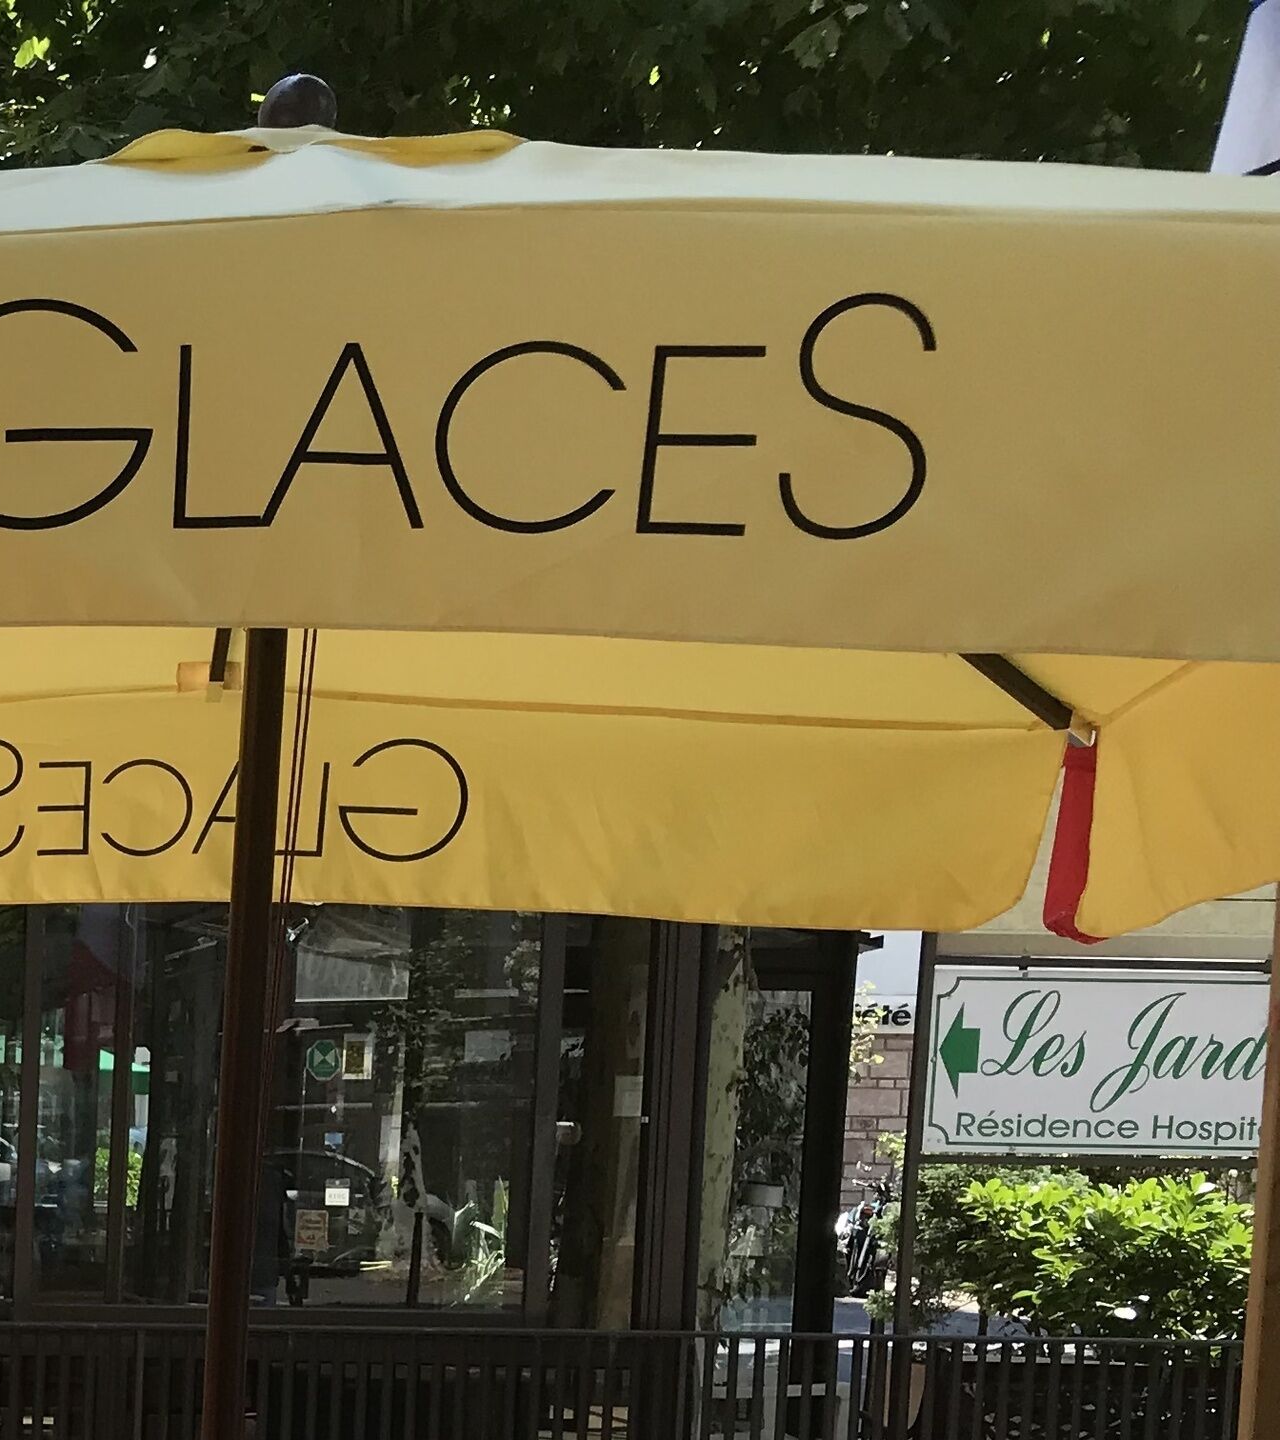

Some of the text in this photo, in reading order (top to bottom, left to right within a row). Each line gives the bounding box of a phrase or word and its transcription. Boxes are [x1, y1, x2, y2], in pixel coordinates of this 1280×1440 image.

[980, 990, 1087, 1078] Les
[955, 1110, 1262, 1146] Résidence Hospit
